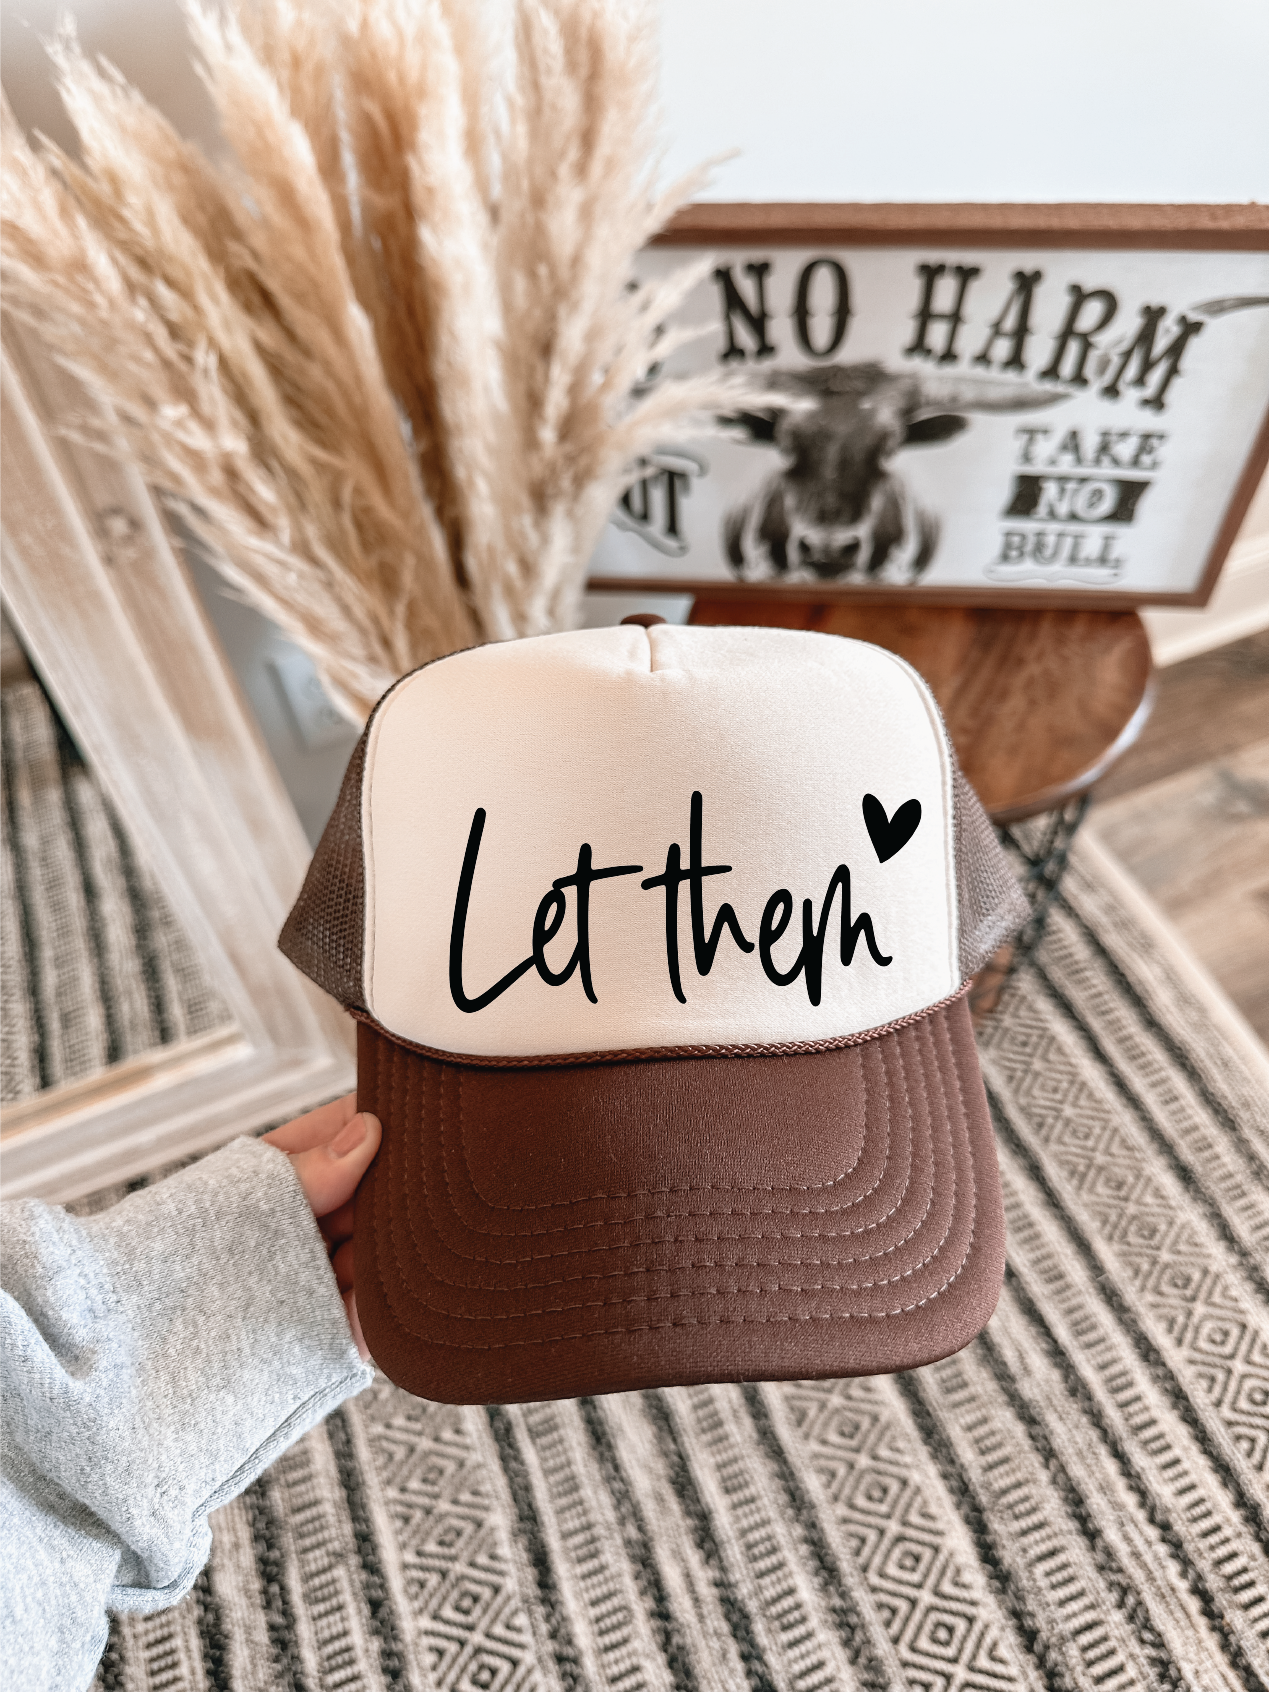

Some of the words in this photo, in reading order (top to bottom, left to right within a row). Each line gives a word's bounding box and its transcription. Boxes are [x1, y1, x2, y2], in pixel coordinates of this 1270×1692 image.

[713, 257, 852, 363] NO
[903, 261, 1204, 413] HARM
[1014, 427, 1168, 471] TAKE
[616, 458, 692, 541] UT
[1031, 480, 1118, 522] NO
[998, 532, 1123, 569] BULL
[449, 807, 643, 1013] Let
[640, 791, 893, 1007] them
